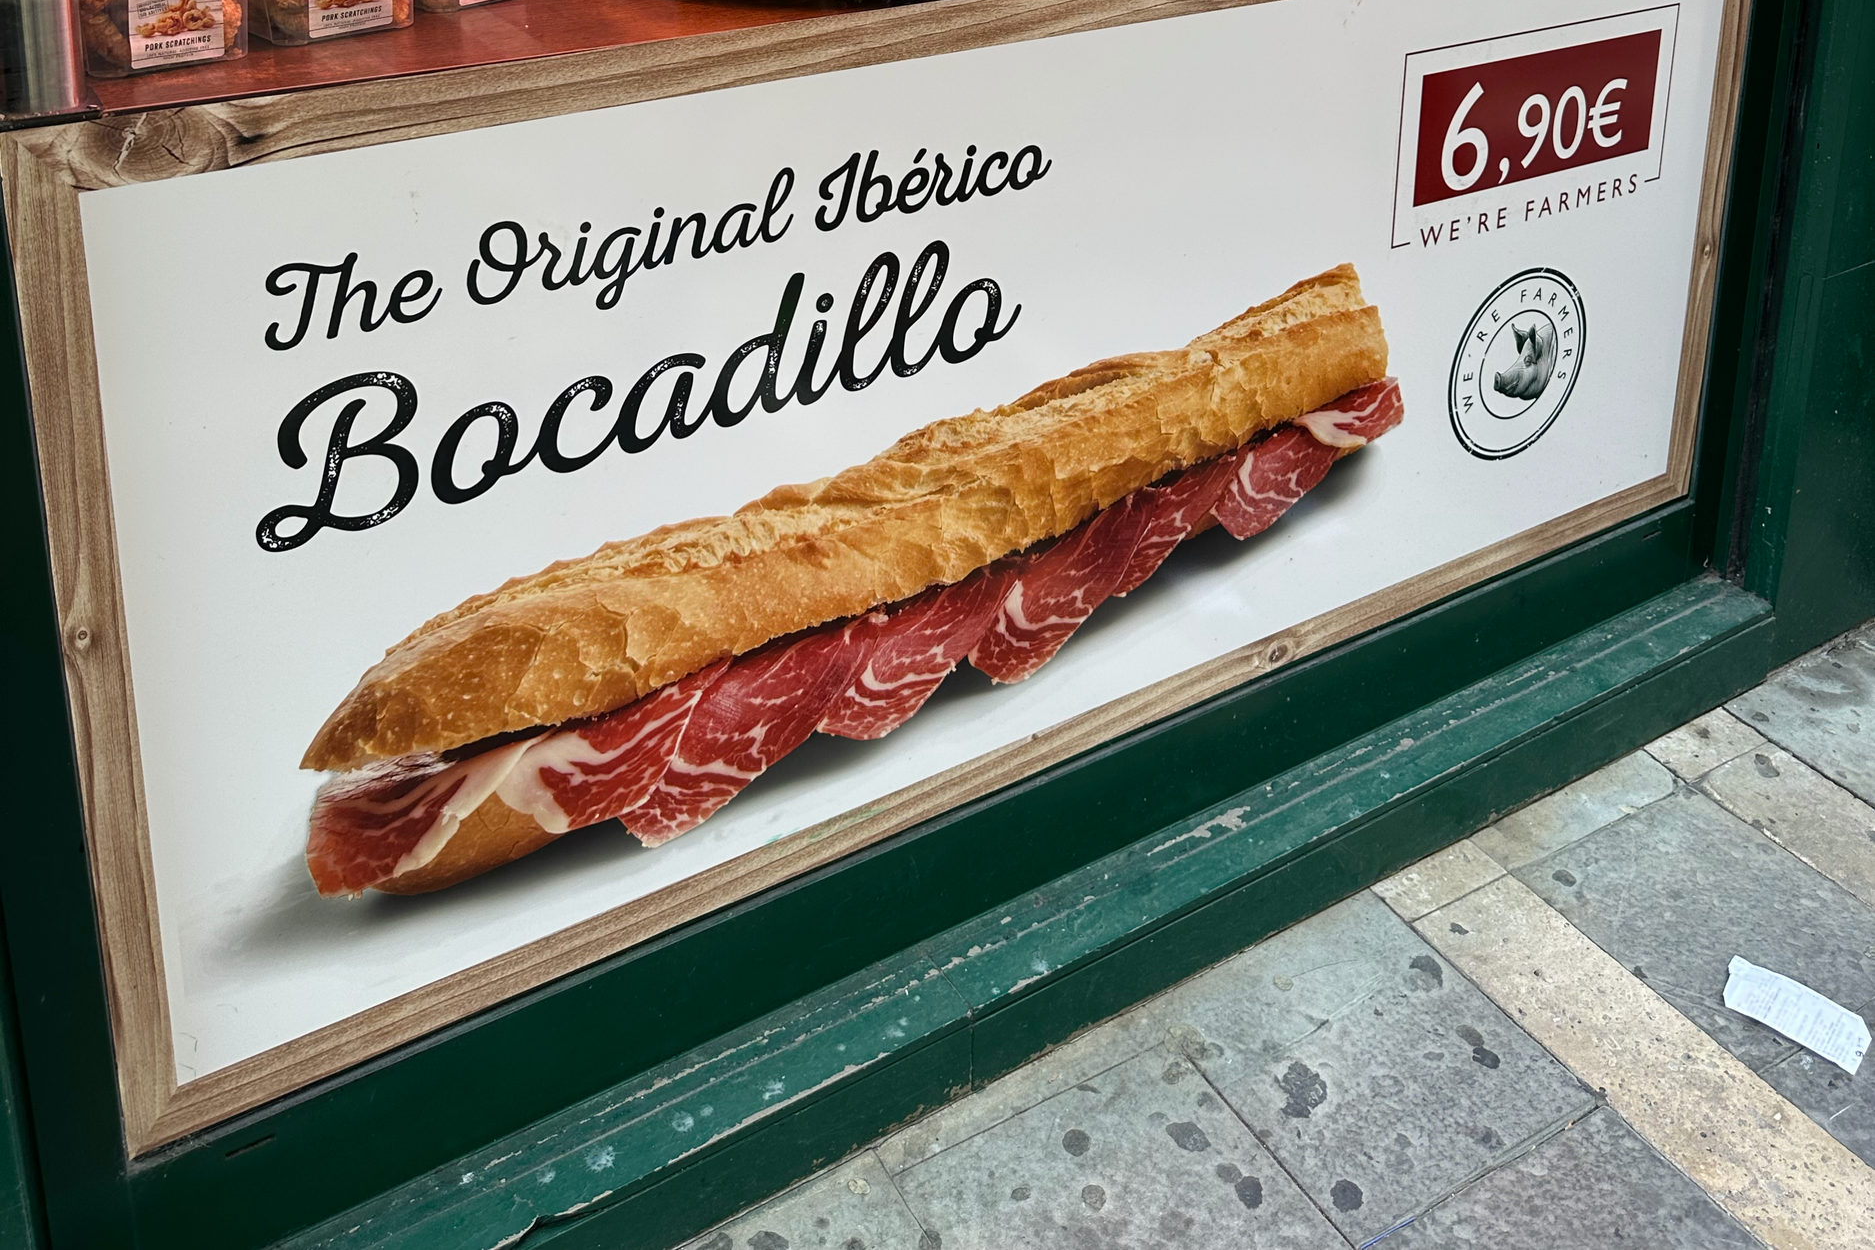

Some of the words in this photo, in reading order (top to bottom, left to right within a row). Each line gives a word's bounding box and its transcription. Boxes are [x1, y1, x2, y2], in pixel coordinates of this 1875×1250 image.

[145, 41, 163, 52] PORK
[165, 35, 212, 49] SCRATCHINGS
[321, 13, 338, 22] PORK
[340, 6, 382, 19] SCRATCHINGS
[1441, 77, 1628, 191] 6,90€
[265, 252, 442, 351] The
[467, 167, 798, 310] Original
[815, 144, 1052, 233] Ibérico
[1420, 207, 1507, 248] WE'RE
[1525, 174, 1638, 221] FARMERS
[1520, 288, 1573, 380] FARMERS
[255, 240, 1023, 553] Bocadillo
